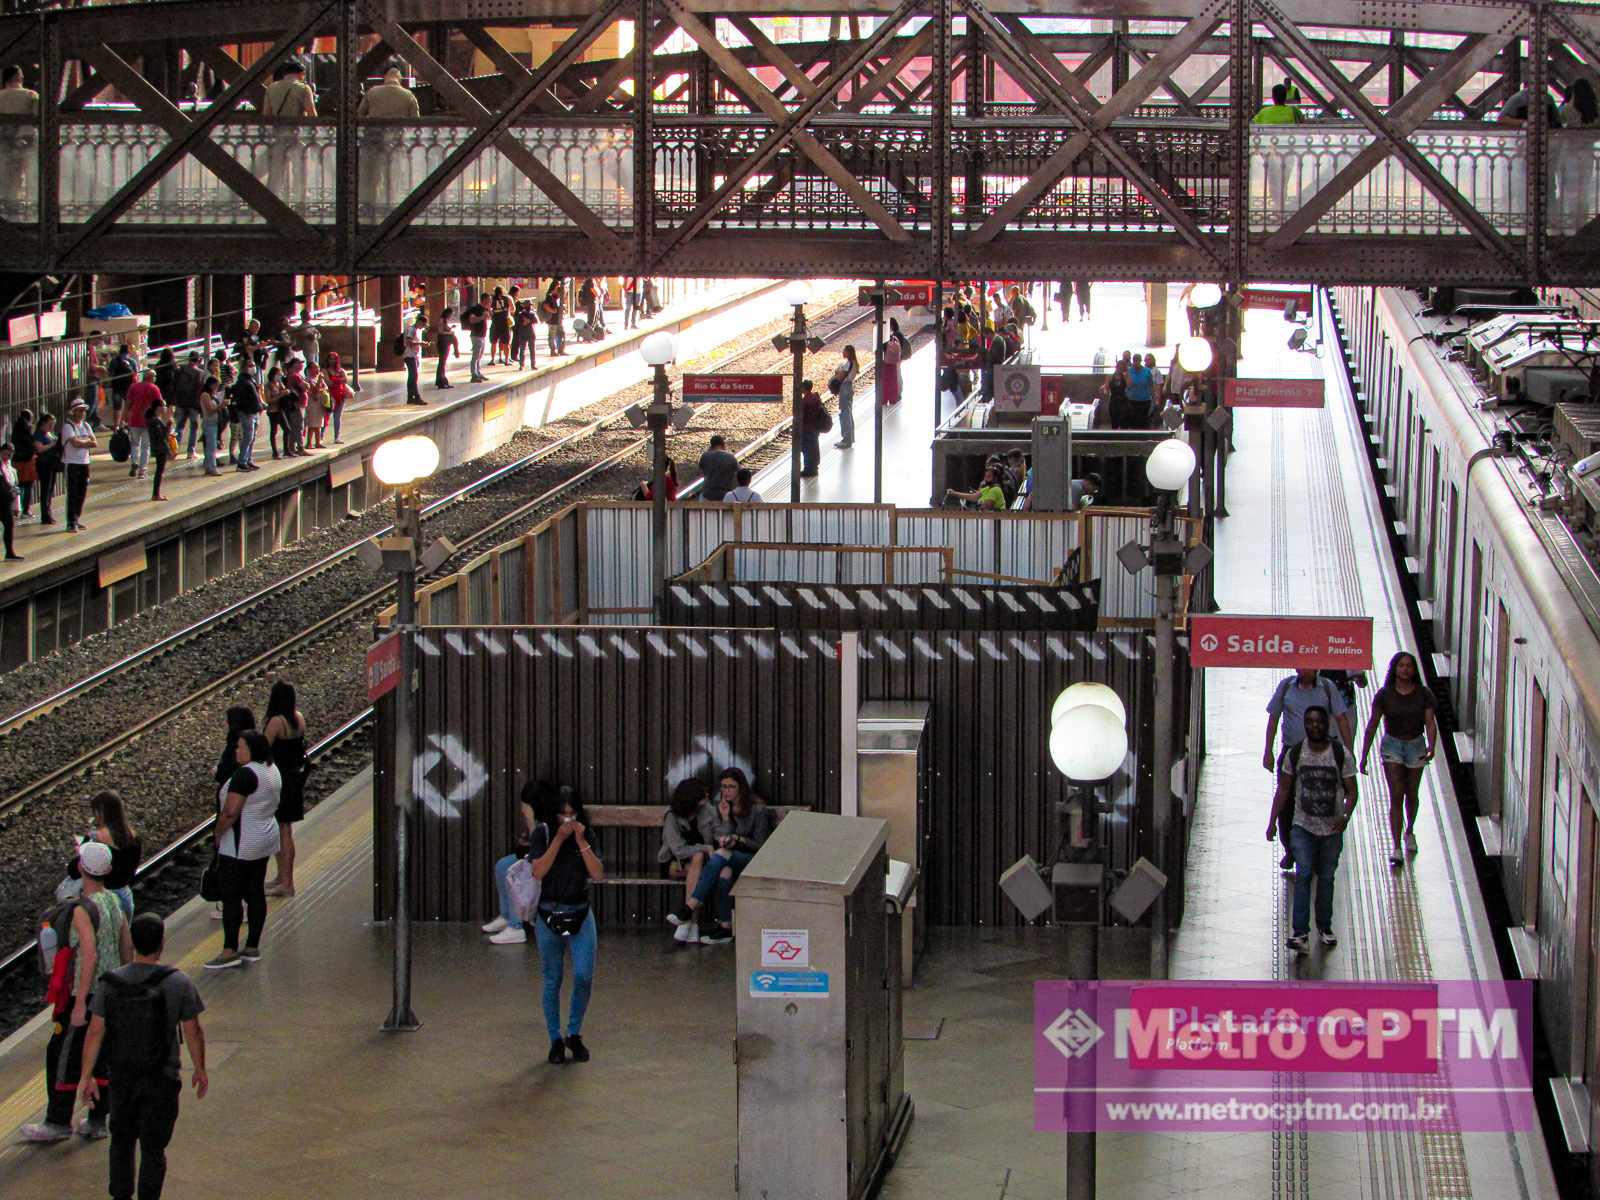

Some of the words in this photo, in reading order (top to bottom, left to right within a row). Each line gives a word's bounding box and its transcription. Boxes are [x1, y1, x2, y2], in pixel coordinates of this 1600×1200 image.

[694, 382, 708, 390] Rio
[720, 382, 731, 390] da
[732, 382, 754, 390] Serra
[1328, 635, 1345, 644] Rua
[1227, 634, 1294, 654] Saída
[1298, 644, 1319, 655] Exit
[1327, 646, 1363, 656] Paulino
